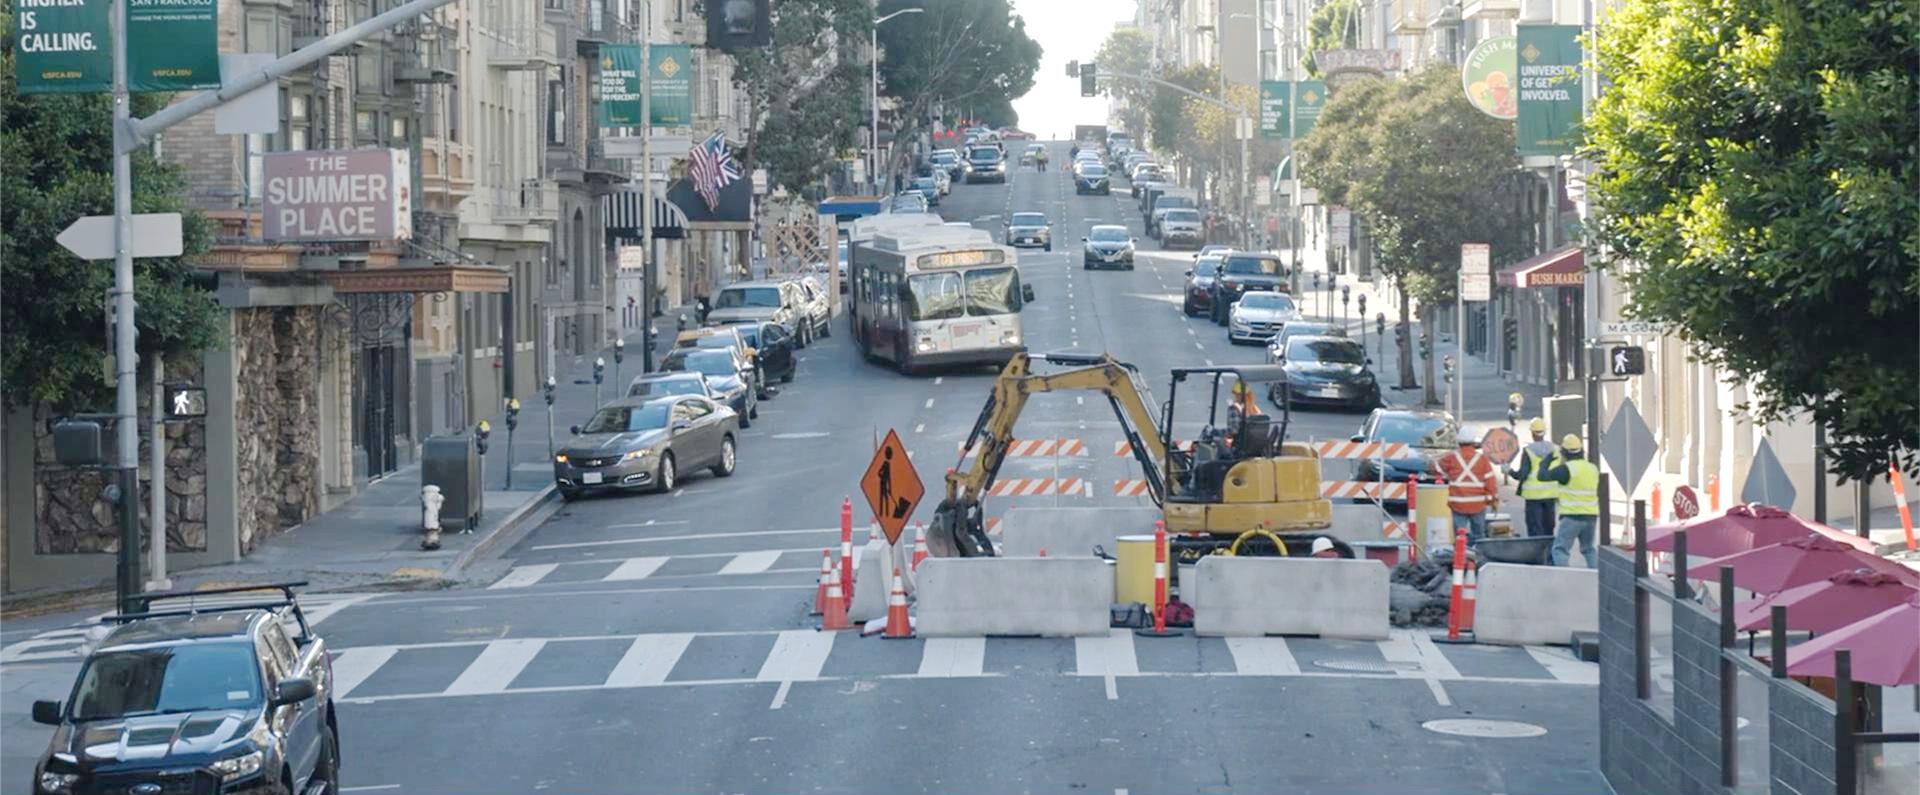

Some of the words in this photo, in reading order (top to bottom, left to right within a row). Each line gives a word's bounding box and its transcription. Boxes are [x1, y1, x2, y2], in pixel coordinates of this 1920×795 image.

[20, 11, 37, 30] IS
[21, 32, 97, 52] CALLING.
[1471, 41, 1498, 69] BUSH
[601, 70, 620, 78] WHAT
[602, 78, 615, 86] YOU
[1521, 77, 1534, 88] OF
[1535, 77, 1552, 88] GET
[1521, 90, 1571, 100] INVOLVED.
[305, 156, 348, 171] THE
[267, 173, 388, 205] SUMMER
[280, 206, 376, 236] PLACE
[1531, 273, 1553, 285] BUSH
[1484, 437, 1517, 456] SLOW
[1674, 491, 1698, 514] STOP
